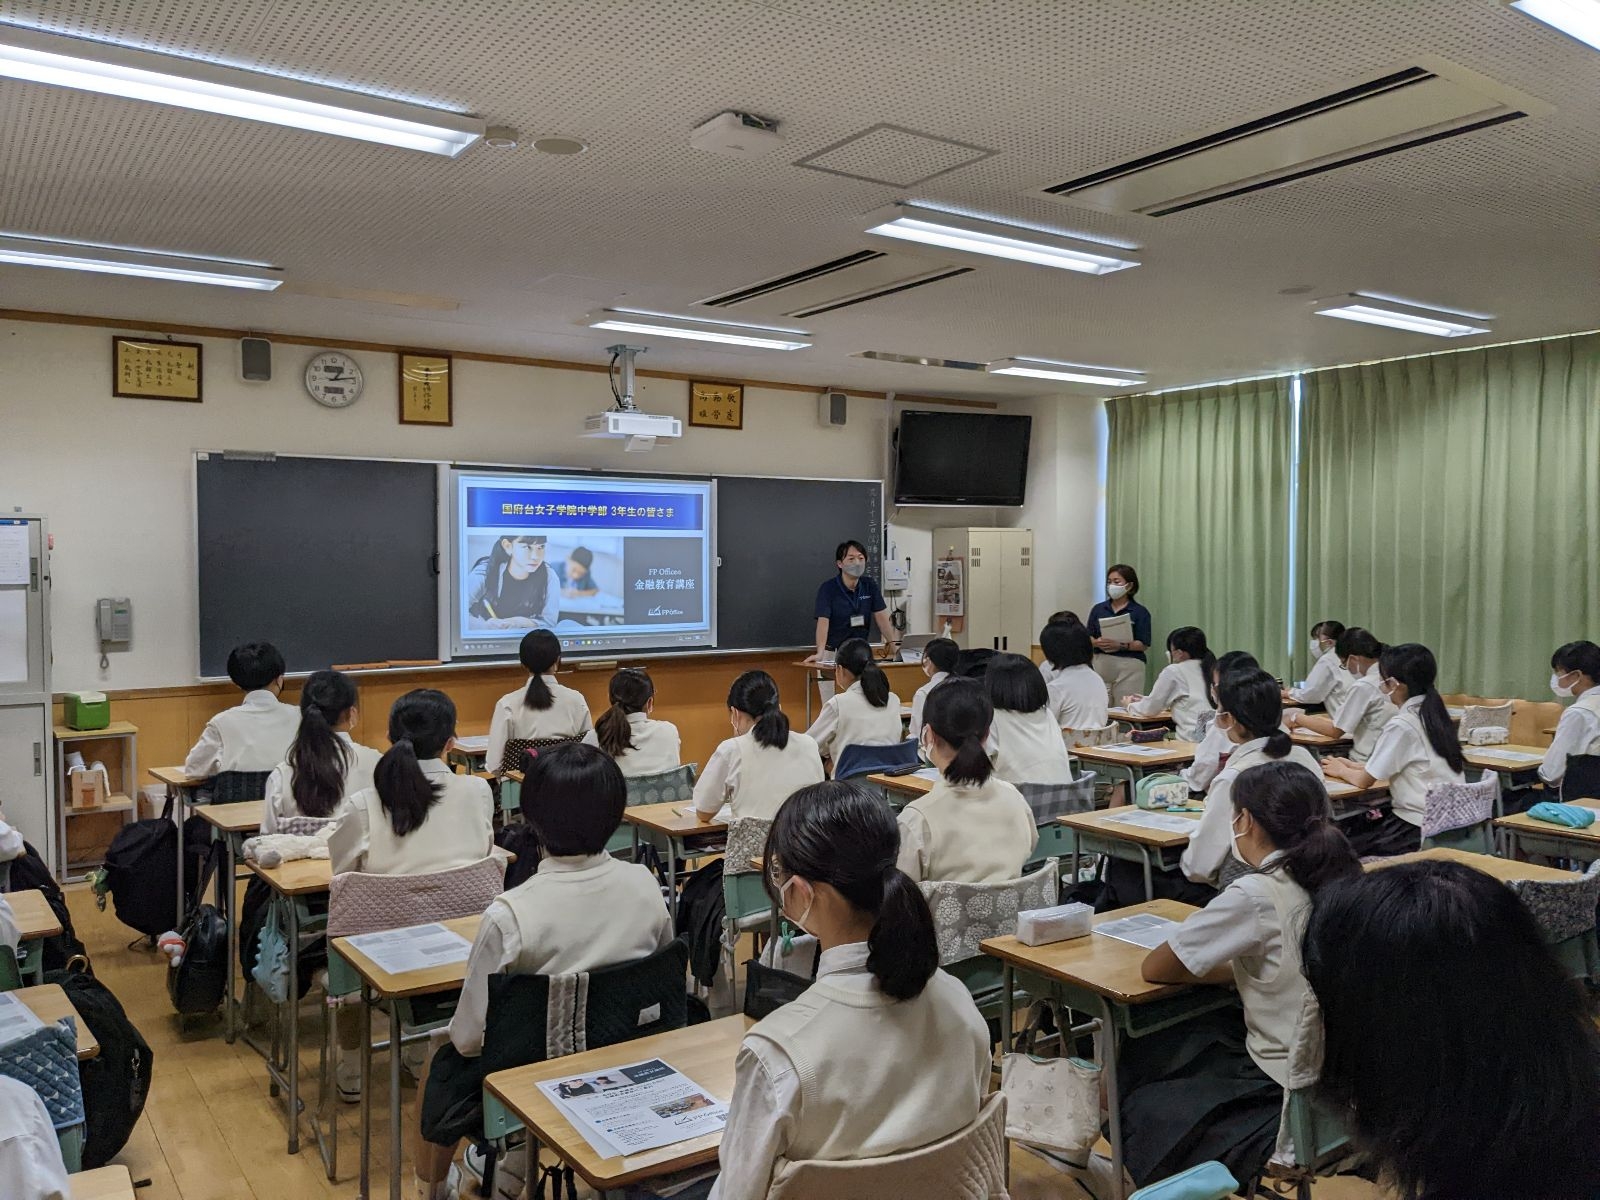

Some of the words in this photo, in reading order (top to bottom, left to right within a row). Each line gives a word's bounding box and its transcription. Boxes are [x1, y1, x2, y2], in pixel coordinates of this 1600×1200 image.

[502, 503, 608, 517] 国府台女子学院中学部
[611, 506, 675, 518] 3年生の皆さま
[648, 568, 658, 576] FP
[634, 578, 695, 590] 金融教育講座
